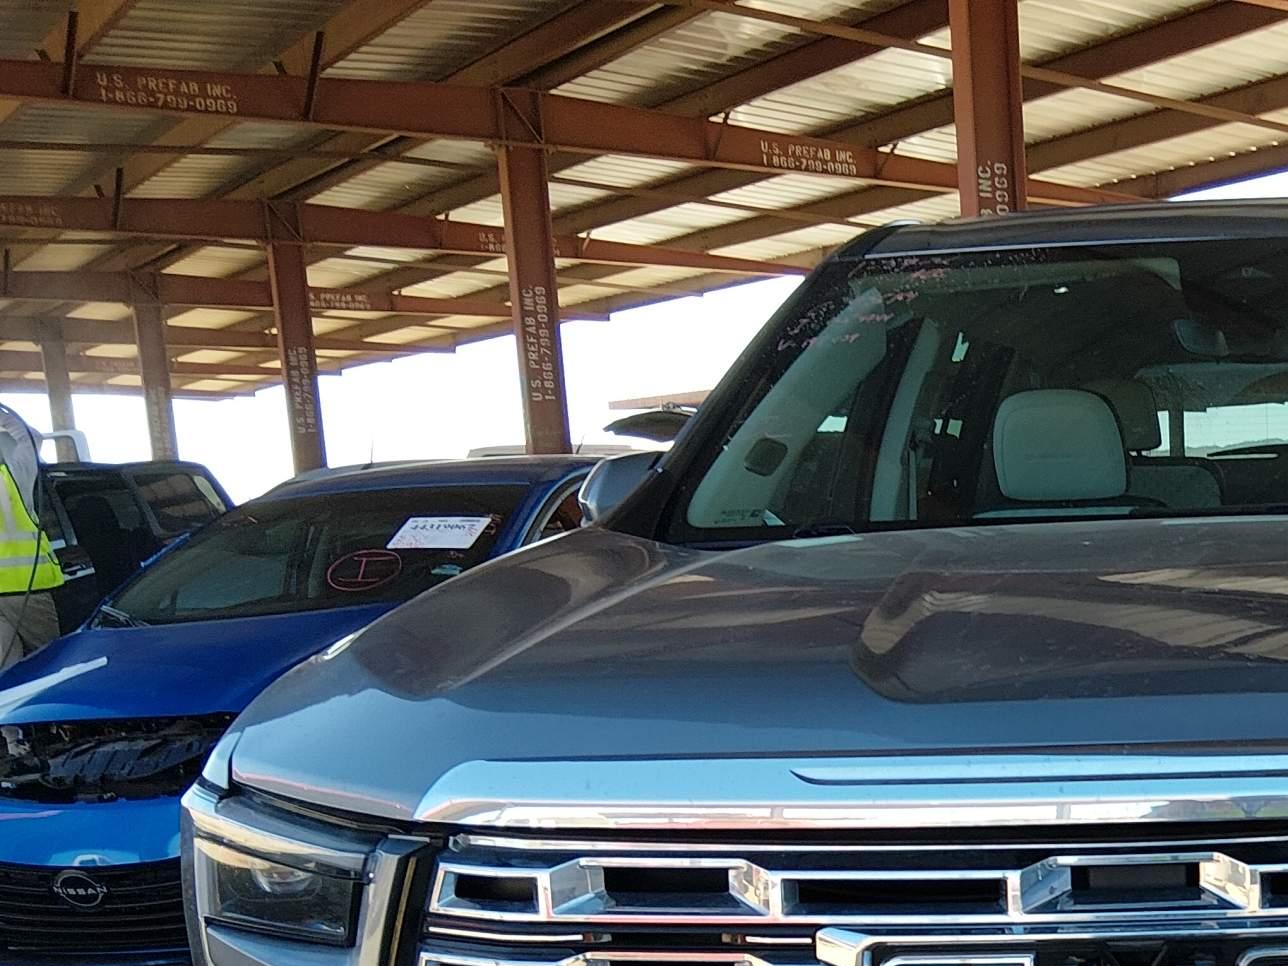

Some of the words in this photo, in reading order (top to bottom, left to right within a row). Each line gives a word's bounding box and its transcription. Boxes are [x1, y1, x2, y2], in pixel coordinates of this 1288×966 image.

[95, 71, 130, 90] U.S.
[136, 76, 200, 96] PREFAB
[206, 82, 238, 99] INC.
[99, 88, 238, 114] 1-866-799-0969
[760, 138, 784, 156] U.S.
[787, 143, 832, 161] PREFAB
[835, 149, 857, 164] INC.
[977, 160, 993, 198] INC.
[521, 285, 535, 311] INC.
[524, 316, 541, 369] PREFAB
[533, 286, 556, 401] 1-866-799-0969
[530, 375, 544, 401] U.S.
[52, 883, 109, 896] NISSAN
